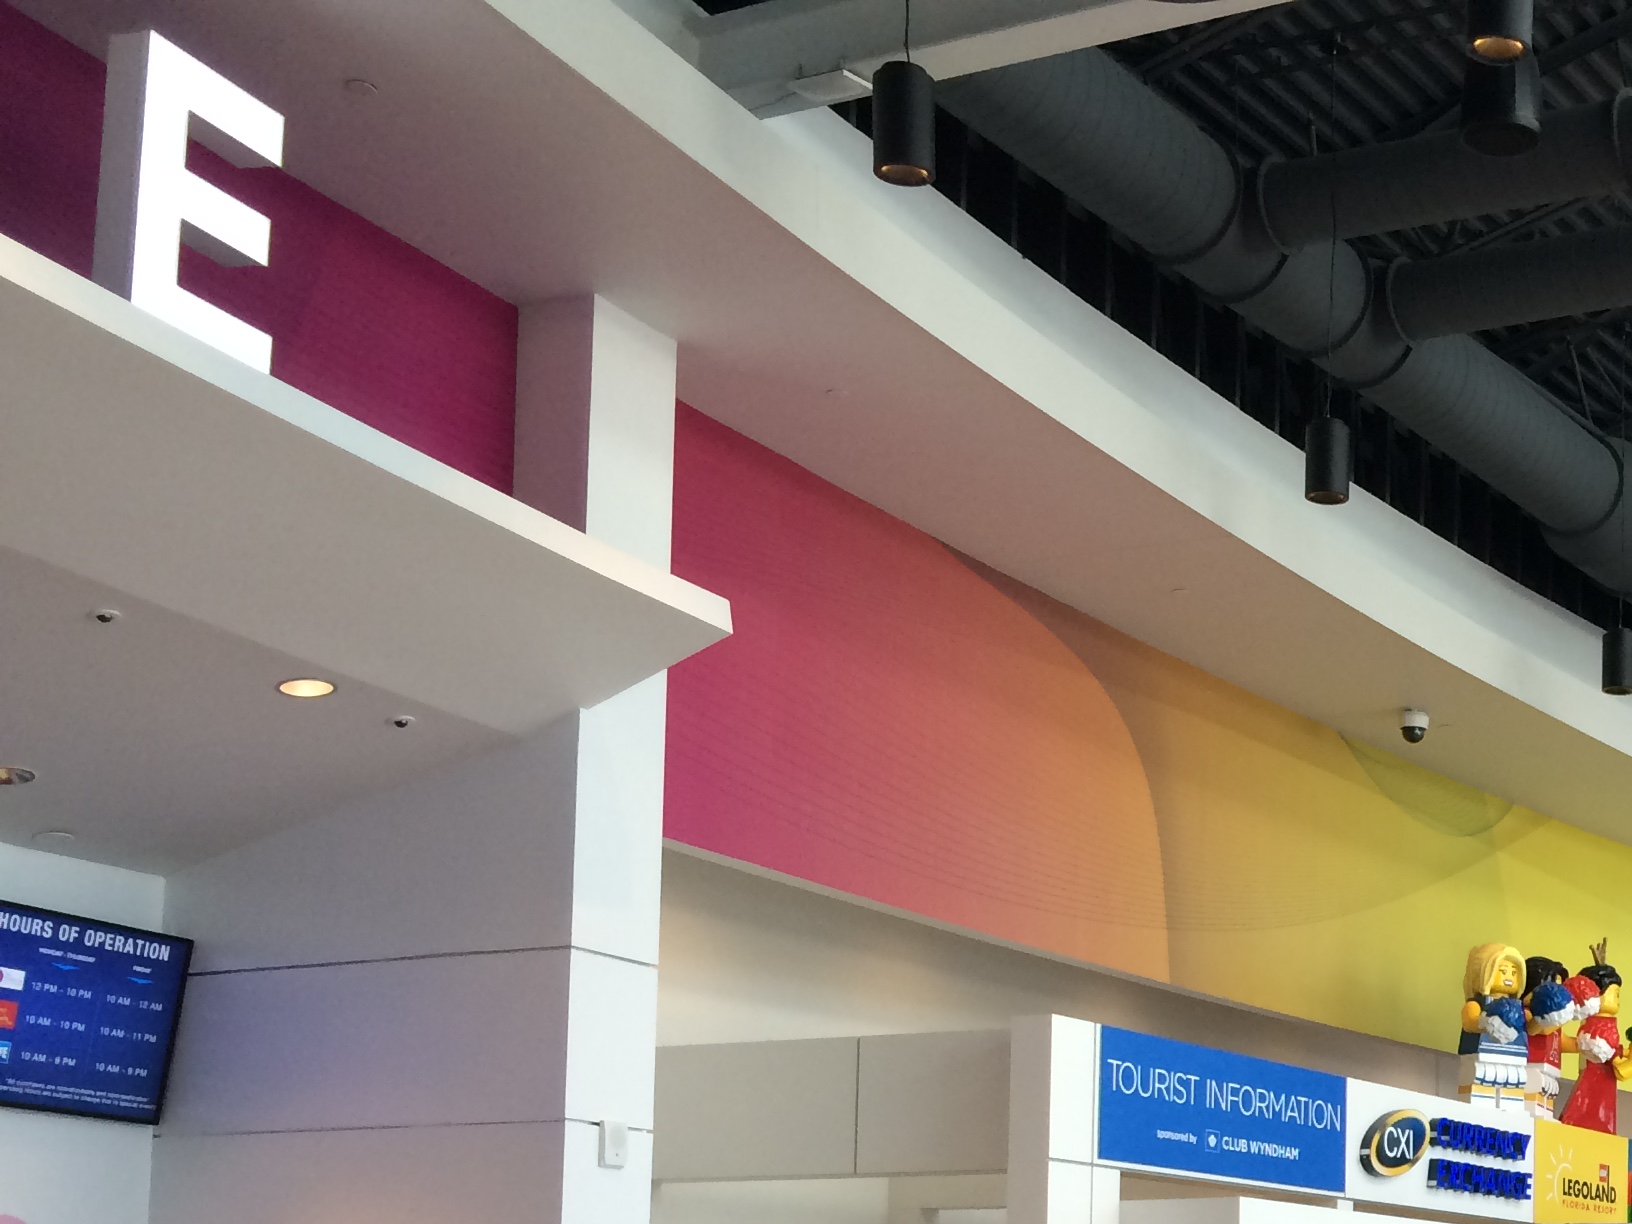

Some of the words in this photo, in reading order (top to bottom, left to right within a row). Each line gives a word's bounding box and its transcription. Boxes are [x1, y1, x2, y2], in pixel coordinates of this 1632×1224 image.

[130, 30, 285, 376] E
[0, 911, 53, 939] HOURS
[59, 924, 80, 943] OF
[84, 929, 171, 962] OPERATION
[1107, 1058, 1200, 1106] TOURIST
[1206, 1078, 1341, 1132] INFORMATION
[1156, 1129, 1188, 1144] sponsored
[1188, 1132, 1198, 1145] by
[1222, 1135, 1248, 1153] CLUB
[1249, 1140, 1300, 1161] WYNDHAM
[1383, 1126, 1415, 1160] CXI
[1434, 1117, 1532, 1161] CURRENCY
[1434, 1158, 1533, 1201] EXCHANGE
[1562, 1176, 1617, 1204] LEGOLAND
[1562, 1199, 1590, 1212] FLORIDA
